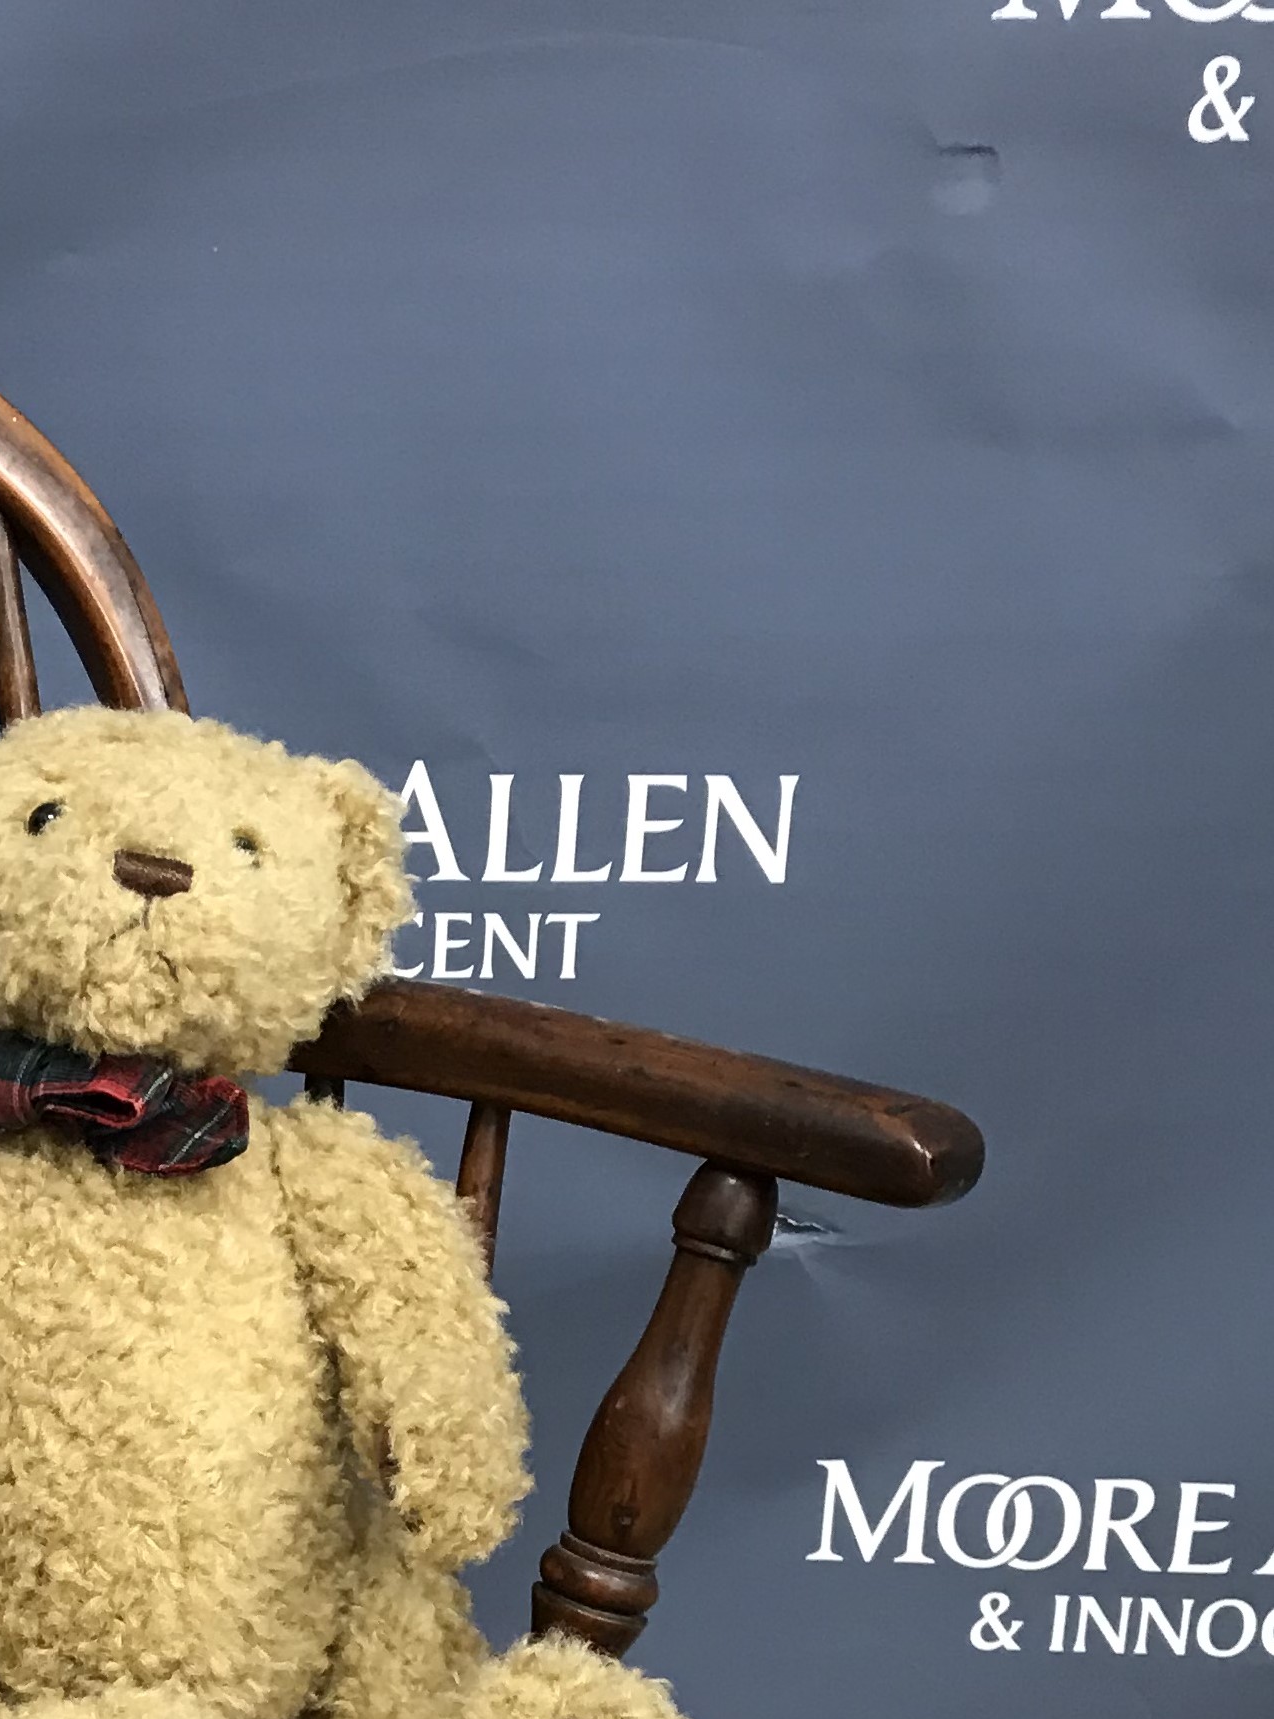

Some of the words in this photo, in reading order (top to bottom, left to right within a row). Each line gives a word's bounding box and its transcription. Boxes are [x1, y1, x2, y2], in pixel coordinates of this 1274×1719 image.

[1187, 55, 1256, 144] &
[399, 758, 801, 884] ALLEN
[805, 1459, 1236, 1575] MOORE
[969, 1591, 1024, 1652] &
[1048, 1594, 1274, 1659] INNO
